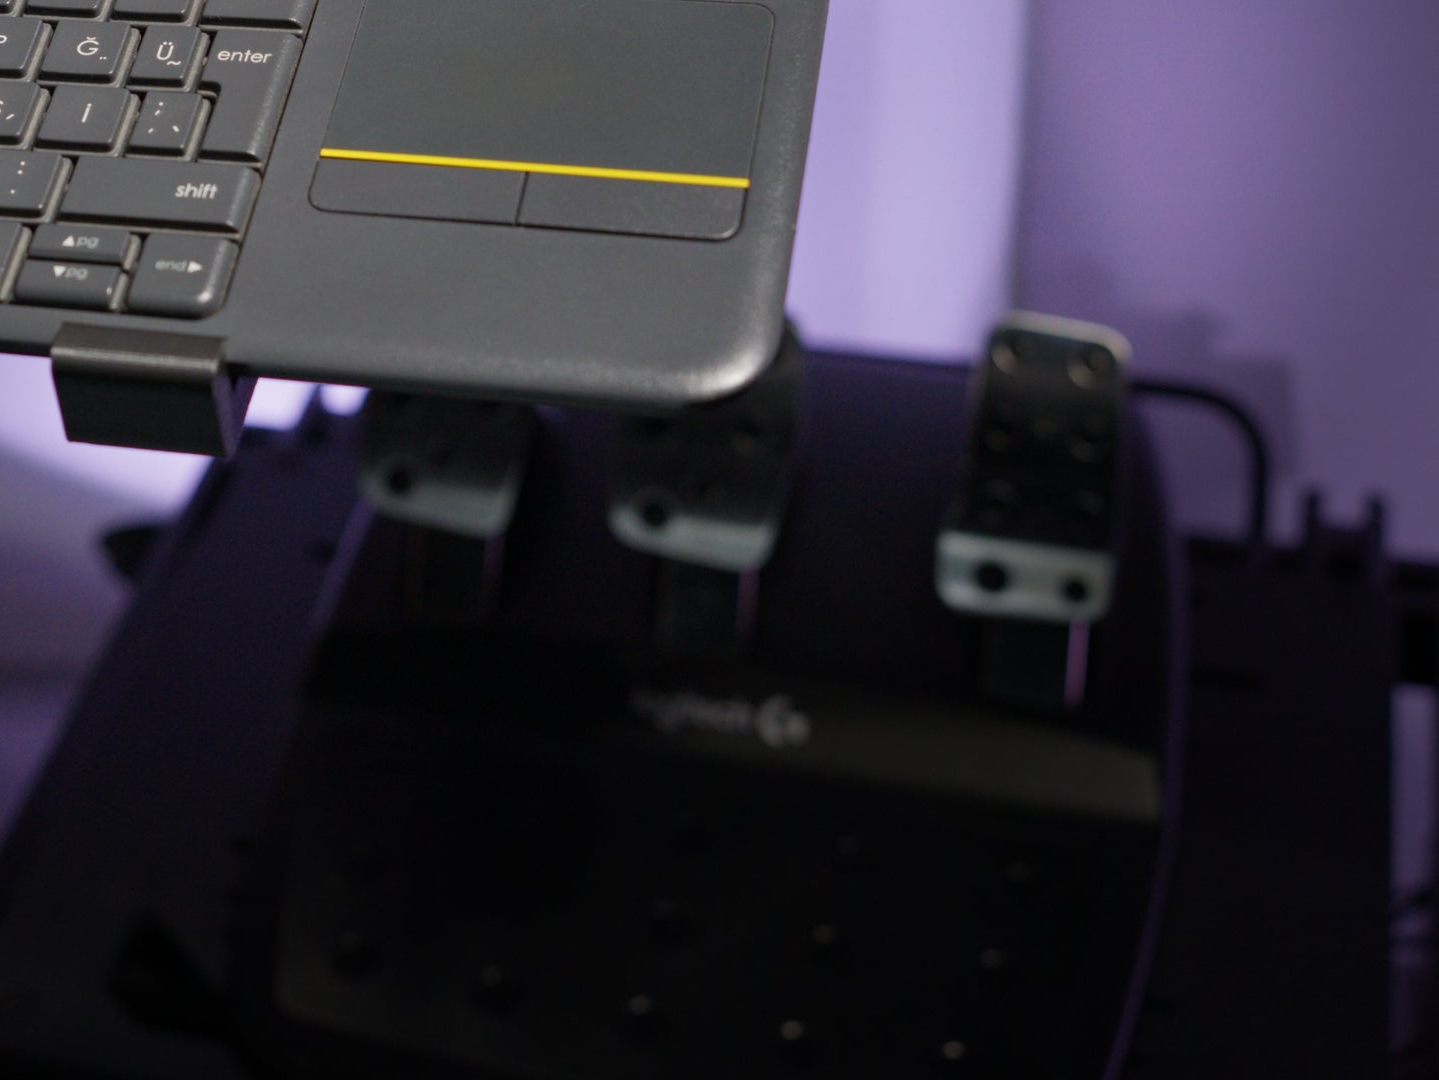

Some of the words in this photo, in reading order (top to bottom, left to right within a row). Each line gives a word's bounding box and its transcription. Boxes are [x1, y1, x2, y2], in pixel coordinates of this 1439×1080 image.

[77, 36, 99, 55] Ğ
[157, 42, 174, 60] Ü
[218, 50, 271, 63] enter
[175, 183, 217, 198] shift
[77, 237, 99, 248] pg
[64, 266, 88, 280] pg
[155, 261, 186, 271] end
